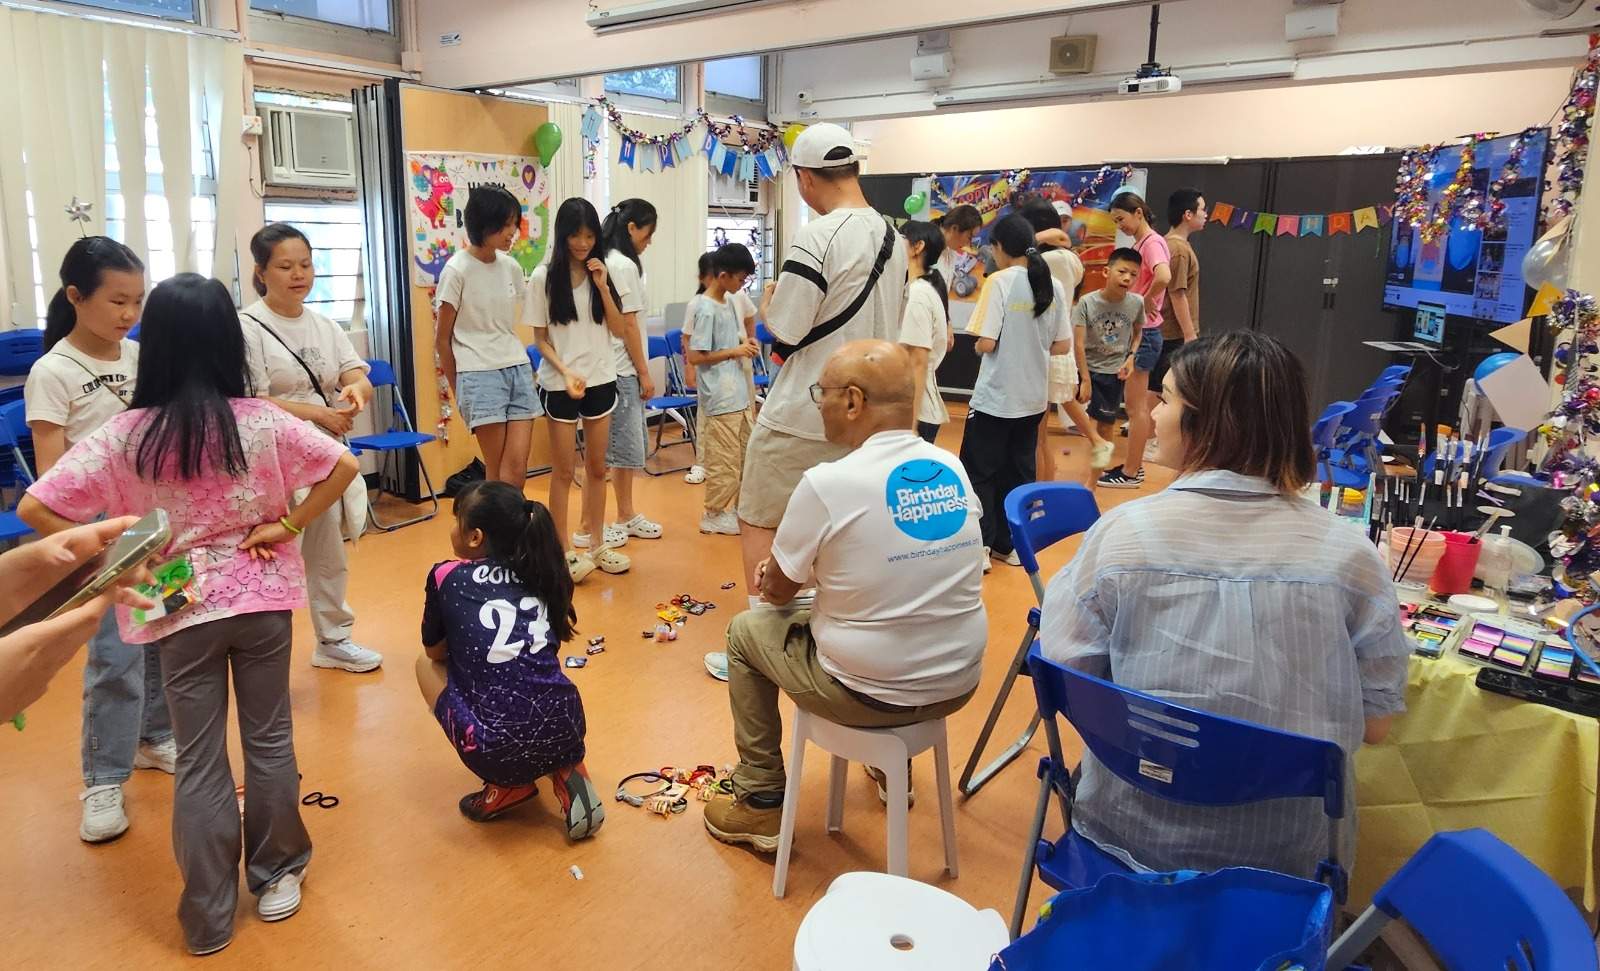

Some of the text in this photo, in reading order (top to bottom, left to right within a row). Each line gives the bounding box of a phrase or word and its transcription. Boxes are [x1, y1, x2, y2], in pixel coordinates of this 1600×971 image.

[888, 495, 969, 524] Happiness
[896, 484, 958, 506] Birthday
[479, 596, 550, 664] 27
